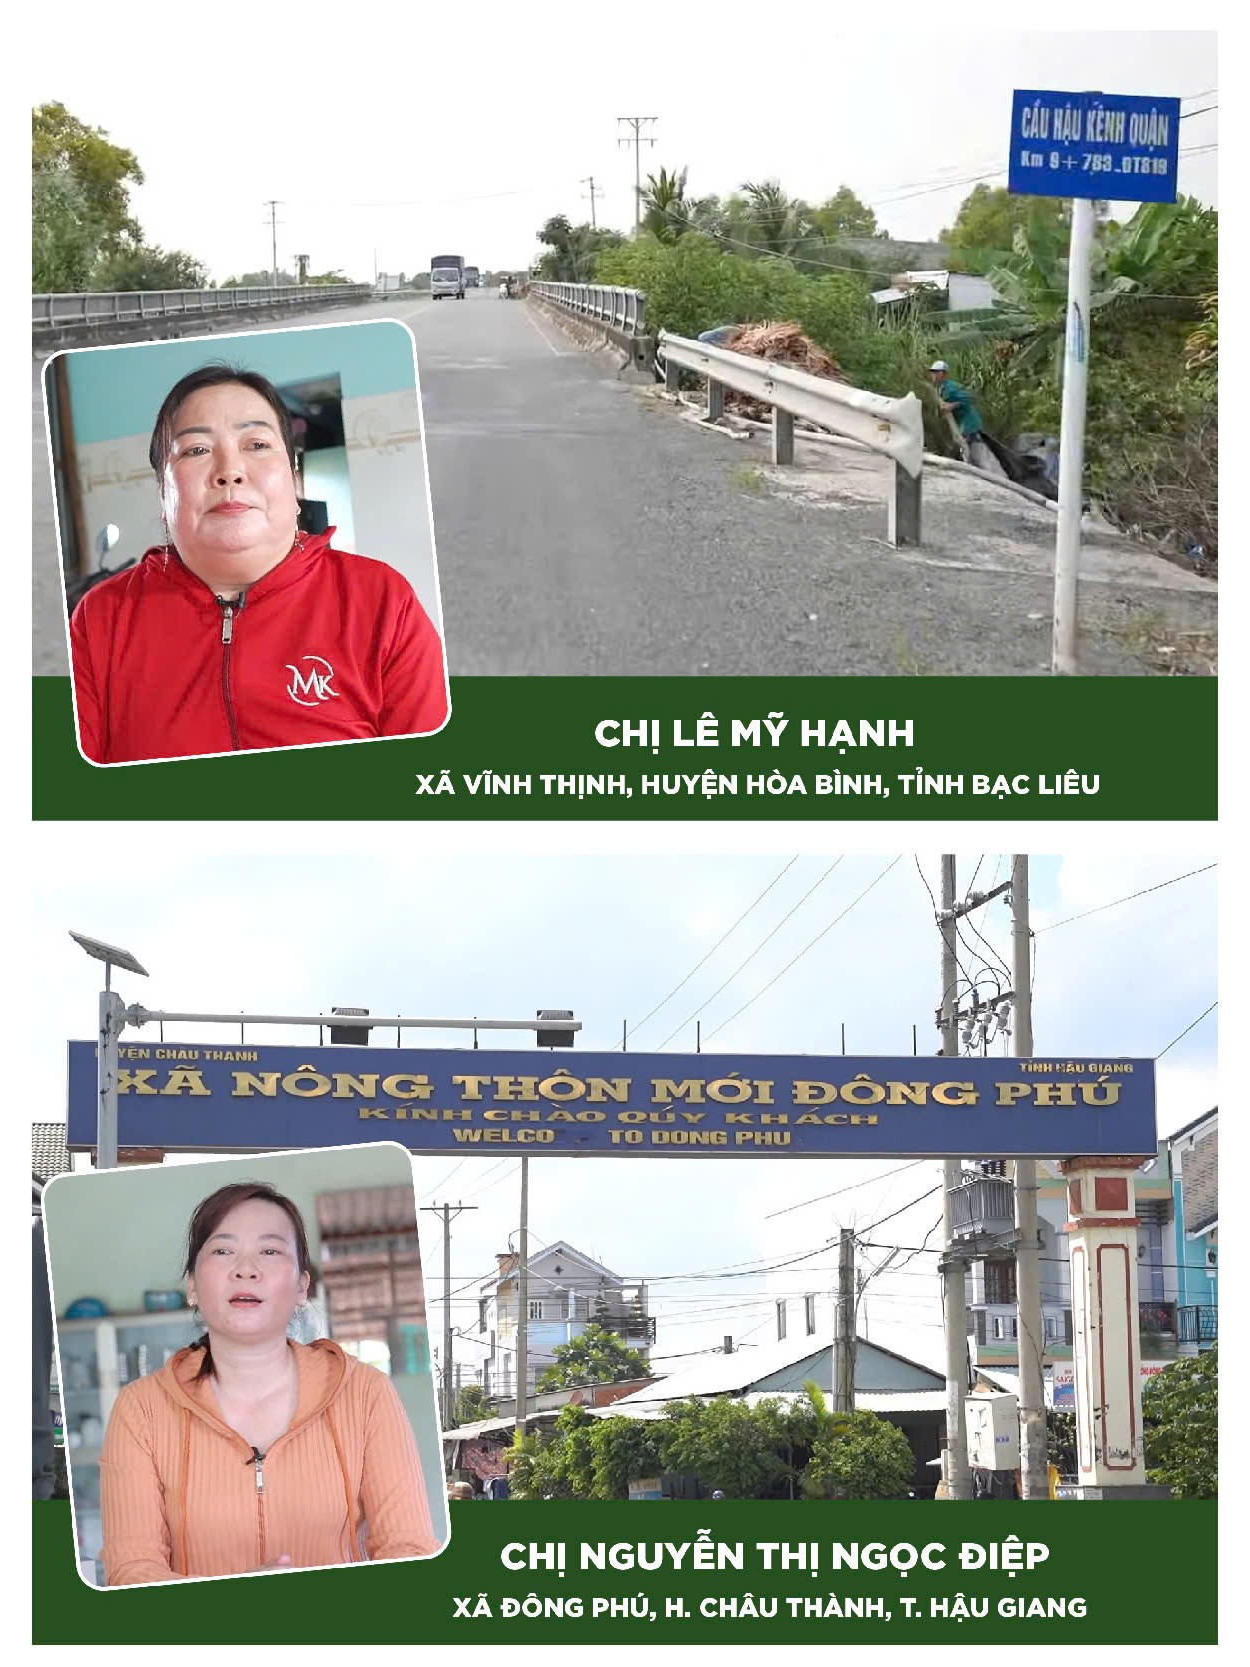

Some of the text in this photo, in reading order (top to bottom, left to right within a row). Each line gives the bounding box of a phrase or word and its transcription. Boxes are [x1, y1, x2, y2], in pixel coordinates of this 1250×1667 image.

[1021, 151, 1043, 168] Km
[1088, 1063, 1134, 1073] GIANG
[116, 1064, 1122, 1107] XÃ NÔNG THÔN MỚI ĐÔNG PHÚ
[357, 1102, 879, 1126] KÍNH CHÀO QUÝ KHÁCH
[608, 1129, 643, 1145] TO
[651, 1130, 727, 1145] DONG
[735, 1131, 791, 1146] PHU
